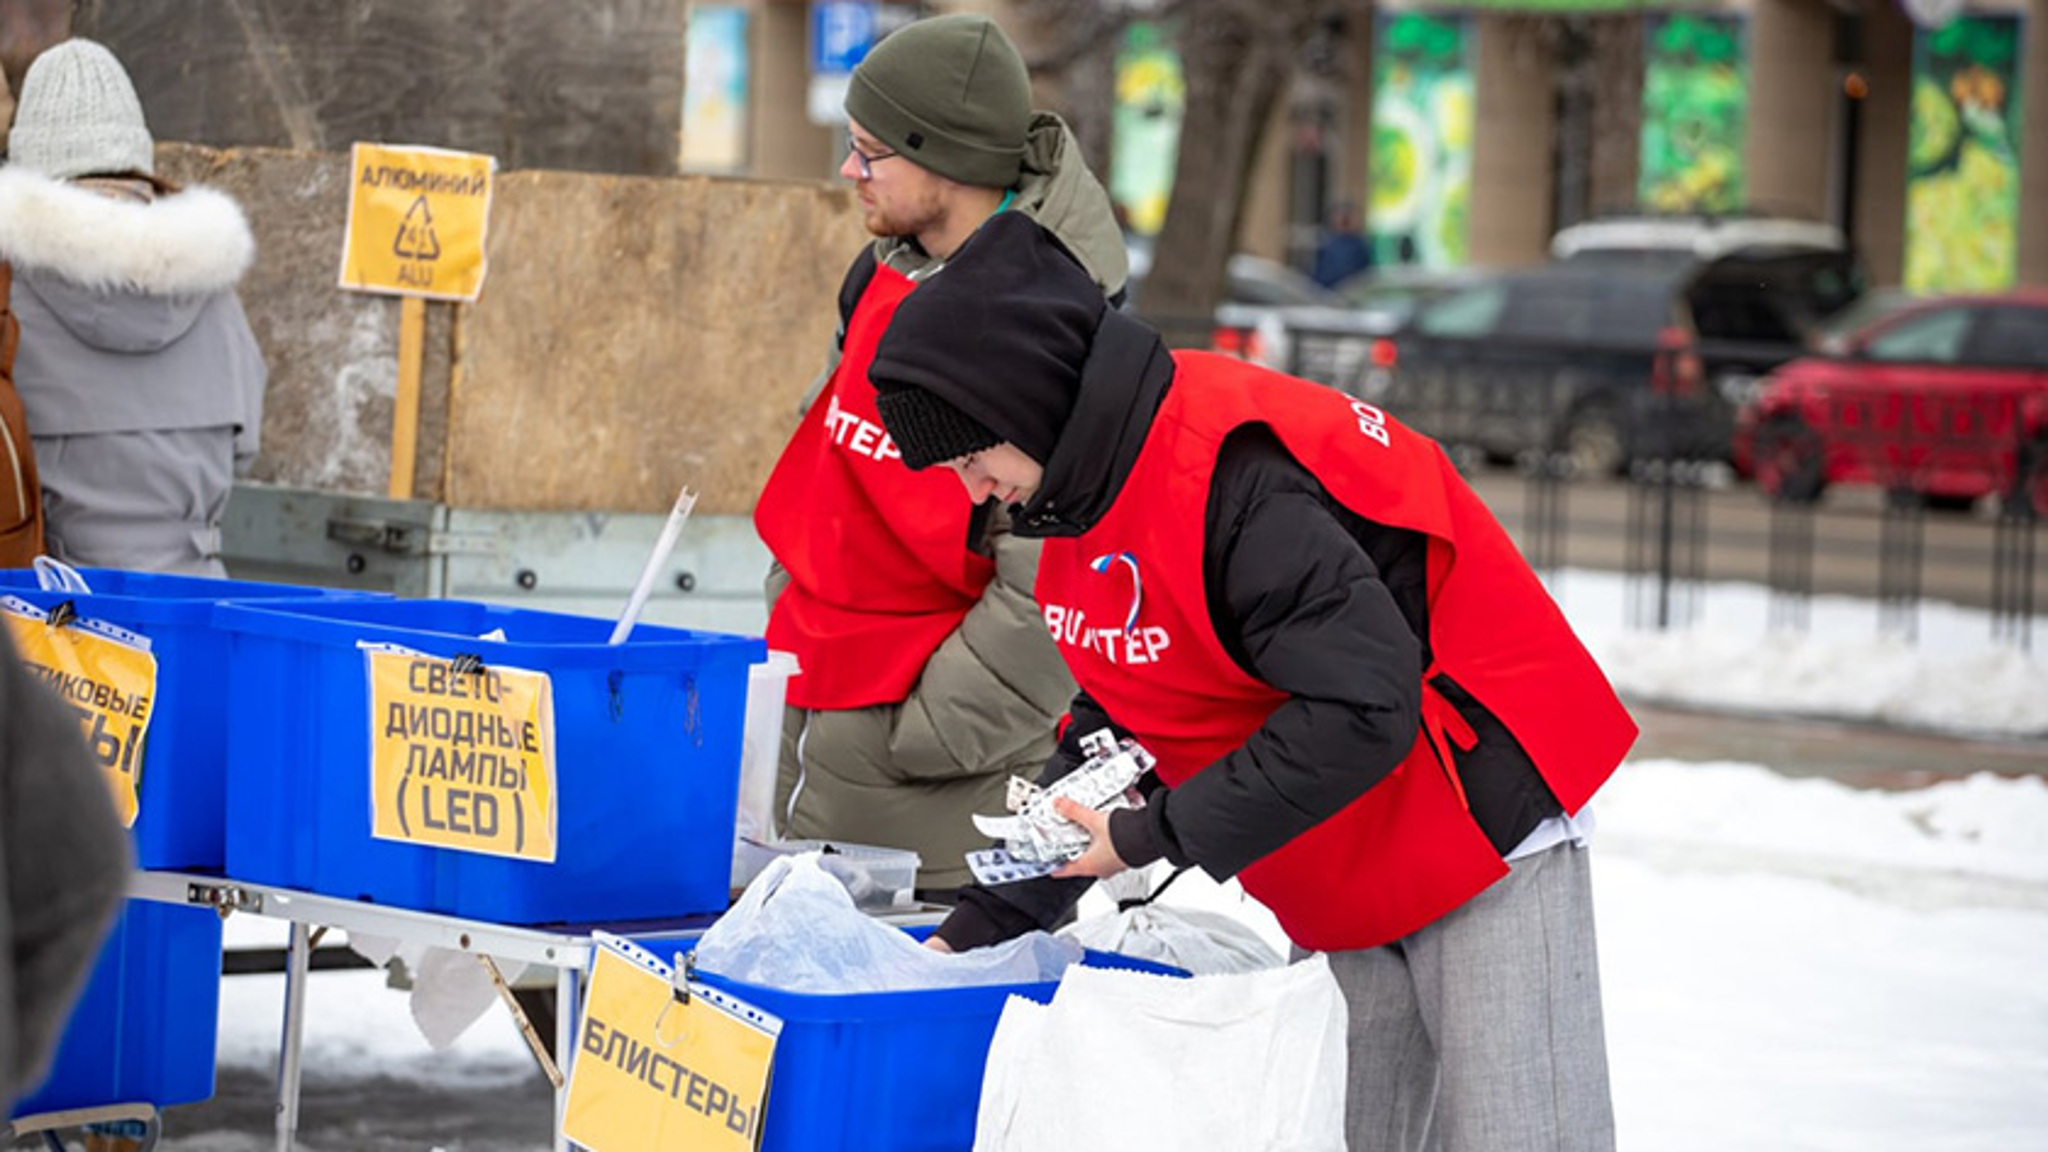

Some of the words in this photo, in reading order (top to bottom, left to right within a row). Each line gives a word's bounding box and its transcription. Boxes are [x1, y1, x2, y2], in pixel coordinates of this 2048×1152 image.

[362, 165, 485, 196] АЛЮМИНИЙ
[406, 226, 429, 249] 41
[397, 264, 434, 286] ALU
[386, 702, 538, 753] ДИОДНЫЕ
[405, 744, 527, 791] ЛАМПЫ
[582, 1016, 757, 1140] БЛИСТЕРЫ
